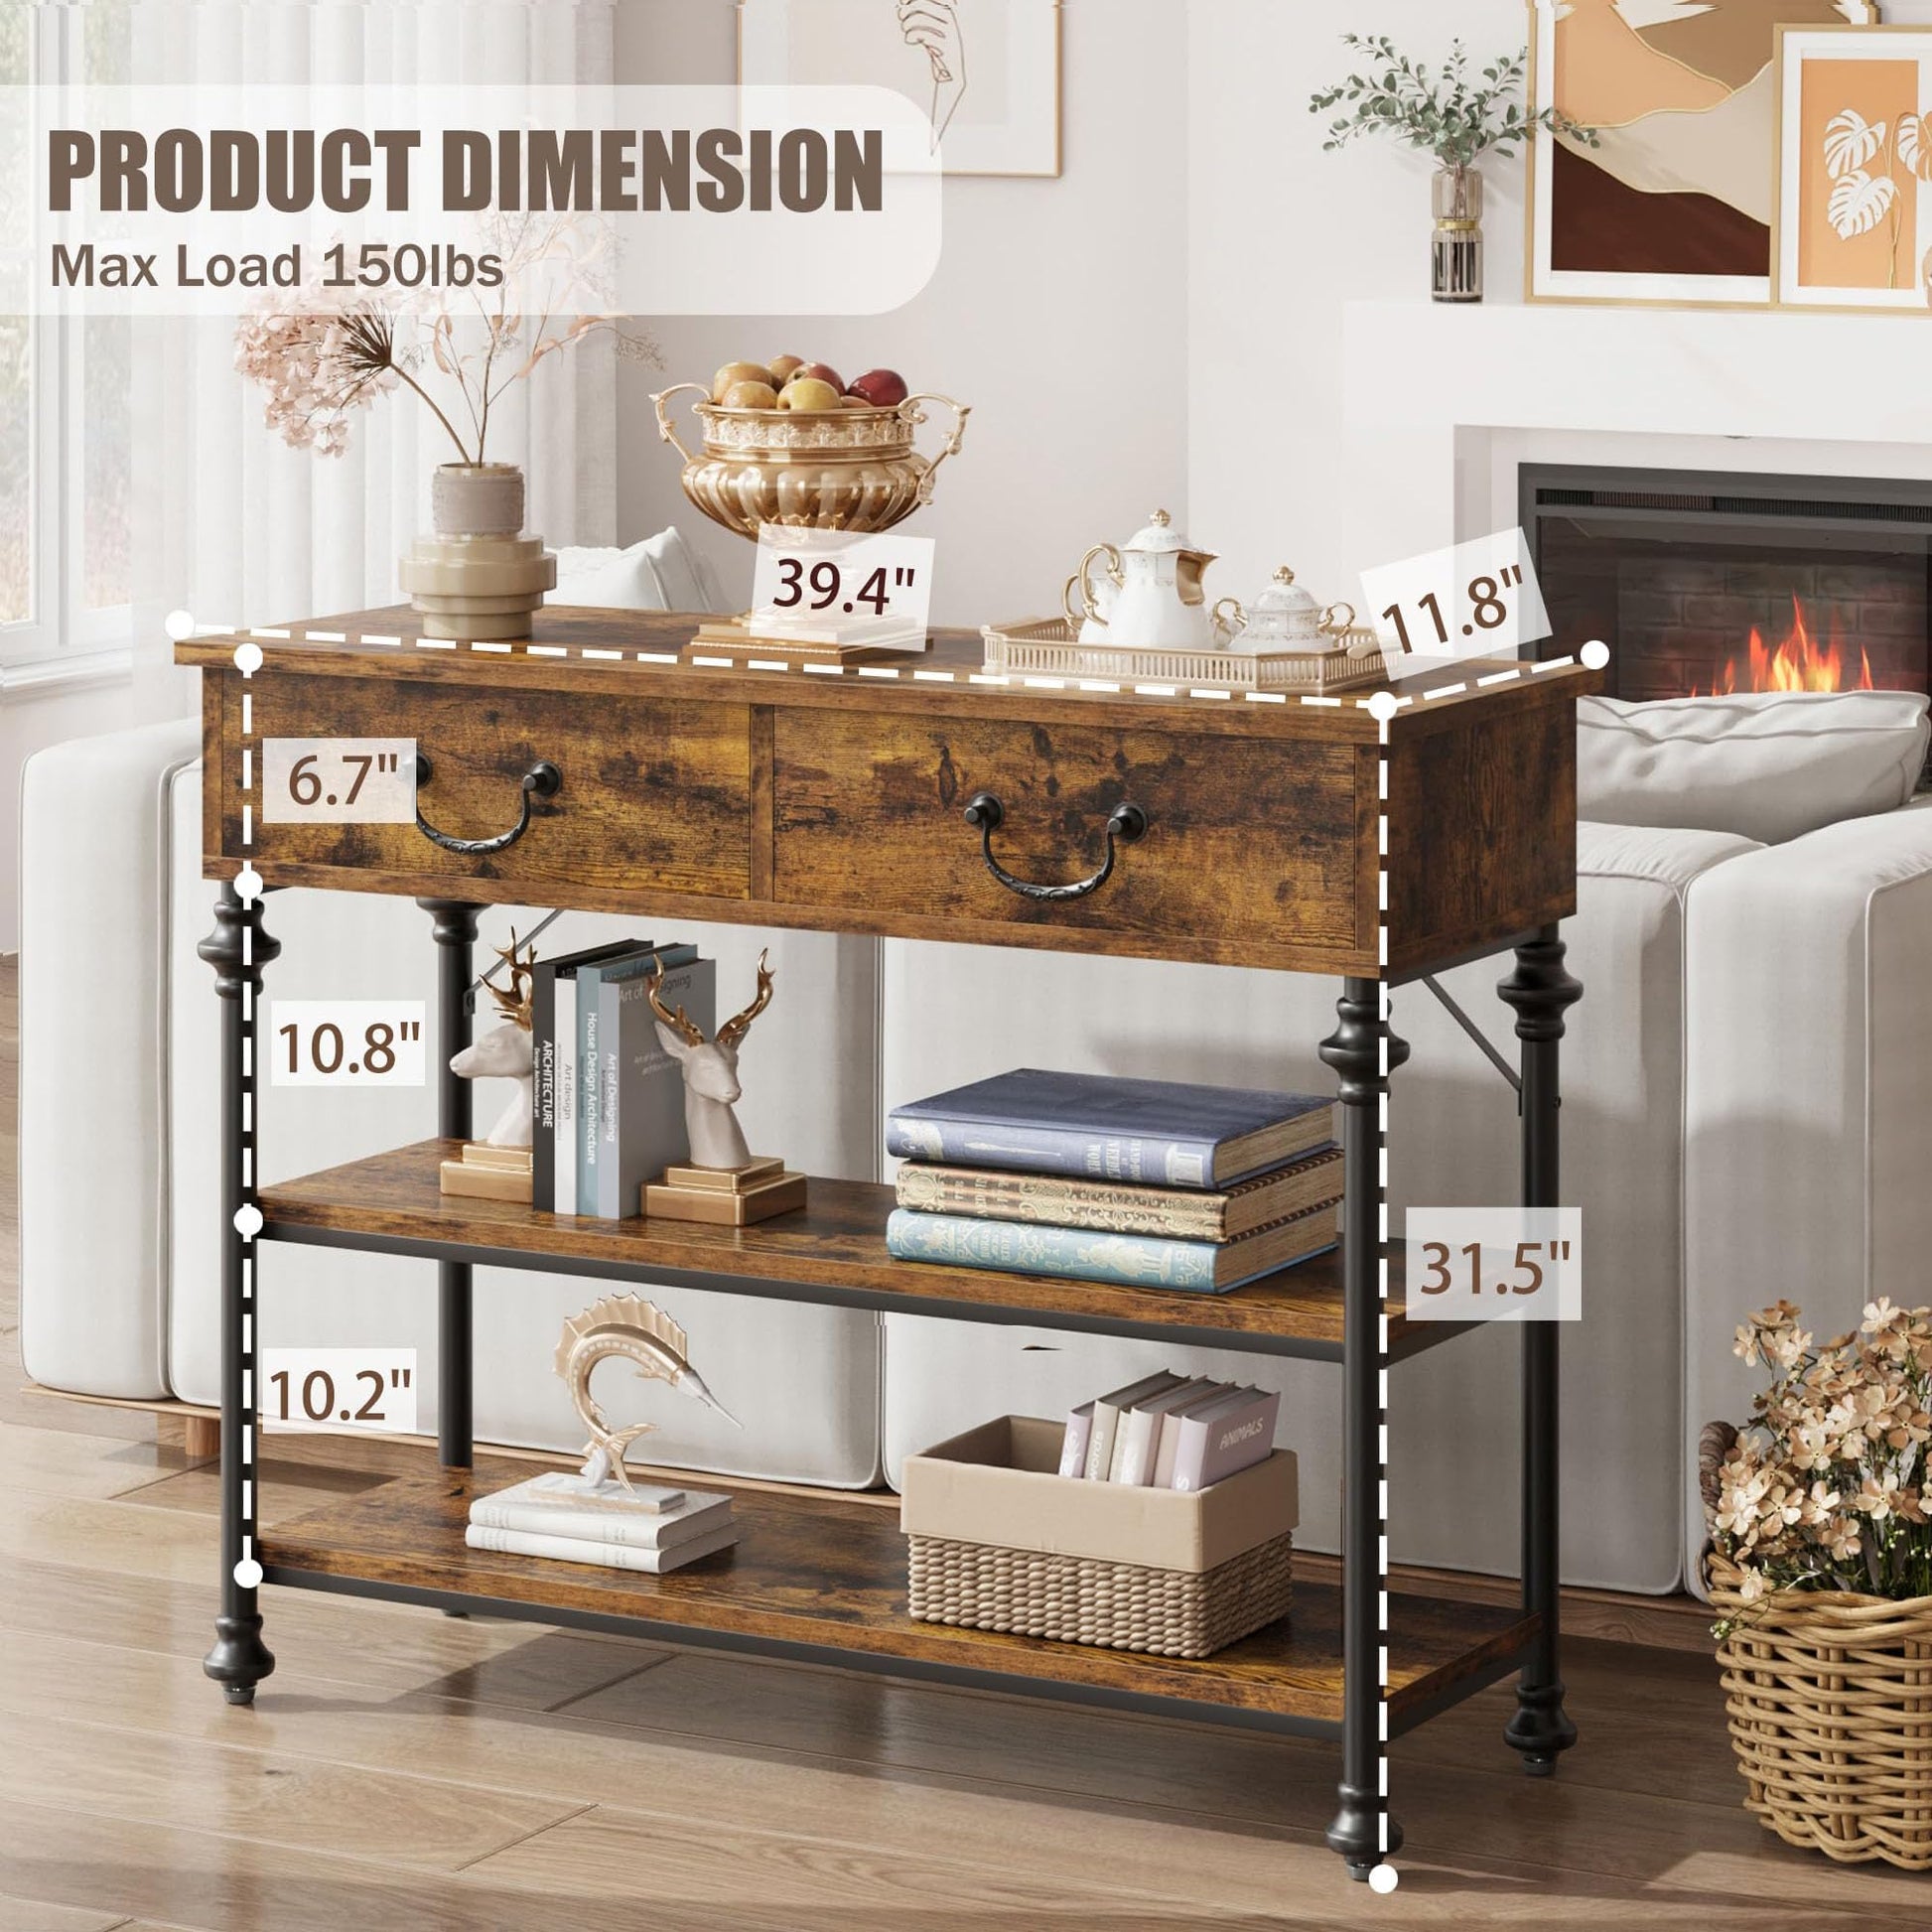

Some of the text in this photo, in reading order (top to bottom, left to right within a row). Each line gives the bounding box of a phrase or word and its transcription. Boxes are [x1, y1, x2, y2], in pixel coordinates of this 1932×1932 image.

[542, 1039, 554, 1128] ARCHITECTURE
[563, 1082, 573, 1120] design
[585, 1013, 598, 1165] House Design Architecture
[606, 1052, 617, 1143] Art of Designing
[1219, 1417, 1264, 1451] ANIMALS
